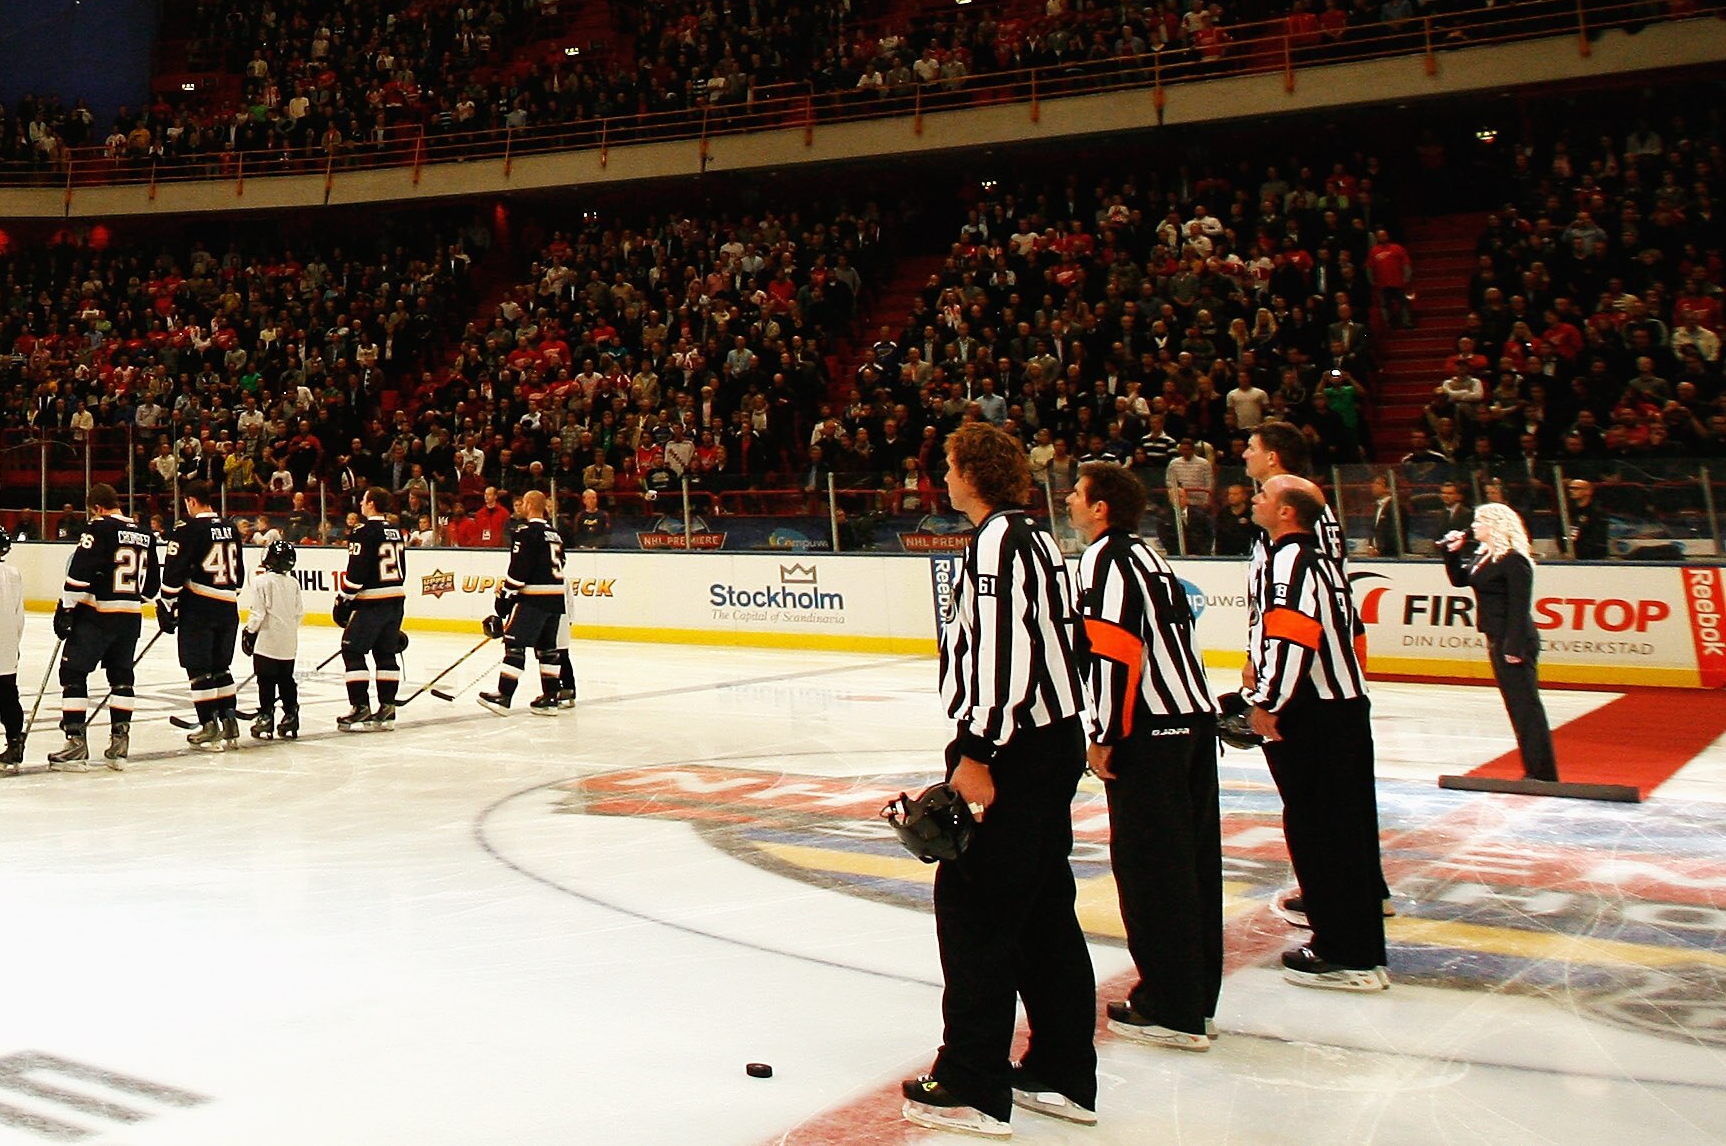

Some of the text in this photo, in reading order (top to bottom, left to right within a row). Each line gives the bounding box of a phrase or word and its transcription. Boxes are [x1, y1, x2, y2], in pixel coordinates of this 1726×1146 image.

[643, 536, 664, 545] NHL
[906, 537, 970, 547] NHL PREMI
[113, 546, 149, 594] 26
[571, 578, 618, 598] ECK
[978, 576, 996, 595] 61
[710, 584, 844, 610] Stockholm
[712, 609, 846, 625] The Capital of Scandinavia
[1403, 594, 1671, 633] FIR STOP
[1688, 569, 1726, 656] Reebok
[1402, 635, 1655, 656] DIN LOKA CKVERKSTAD
